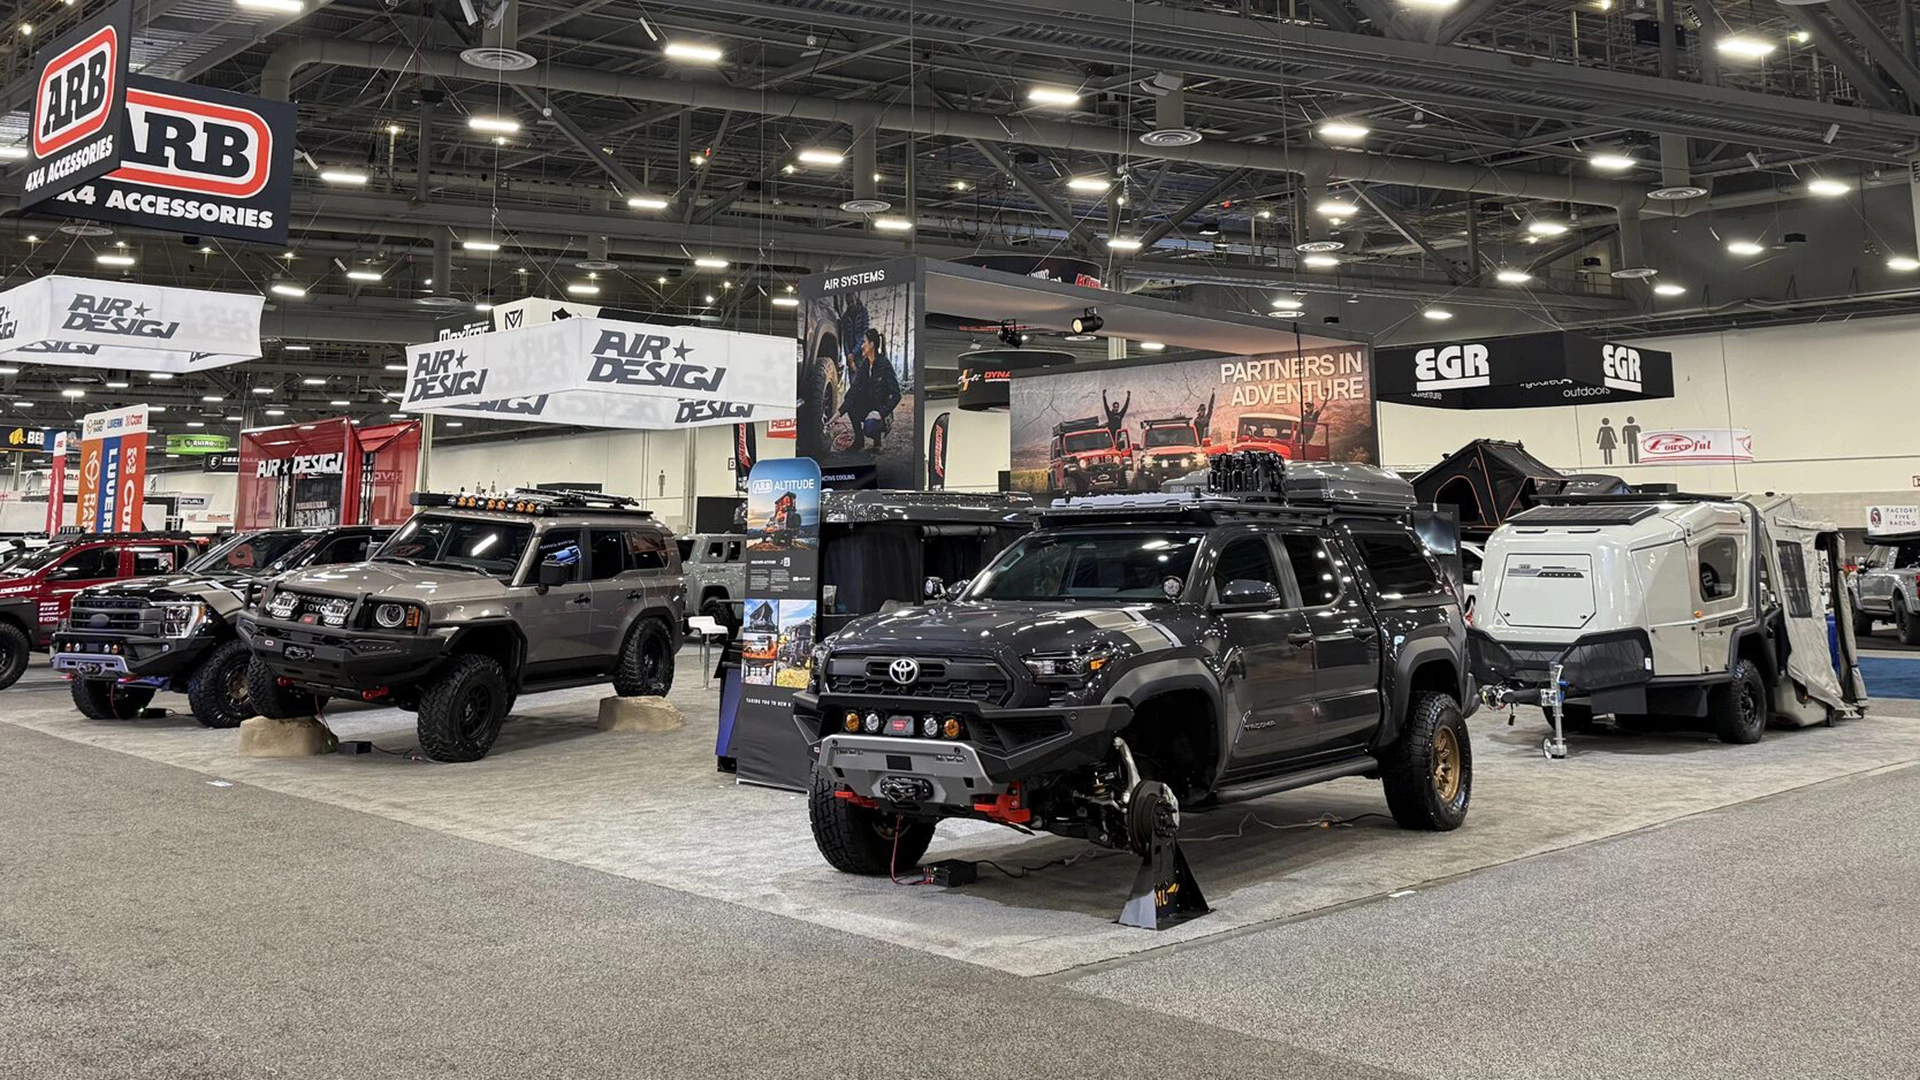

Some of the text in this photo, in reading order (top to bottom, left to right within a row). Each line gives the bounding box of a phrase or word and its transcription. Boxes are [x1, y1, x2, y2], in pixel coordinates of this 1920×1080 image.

[43, 49, 107, 138] ARB
[25, 135, 114, 192] 4X4 ACCESSORIES
[105, 190, 273, 229] ACCESSORIES
[824, 270, 885, 290] AIR SYSTEMS
[68, 293, 133, 317] AIR
[62, 312, 180, 340] DESIGN
[591, 329, 671, 360] AIR
[416, 348, 454, 376] AIR
[587, 356, 727, 392] DESIGN
[1221, 351, 1362, 384] PARTNERS IN
[1415, 344, 1490, 380] EGR
[1603, 344, 1643, 382] EGR
[408, 368, 489, 402] DESIGN
[1231, 377, 1365, 406] ADVENTURE
[1563, 386, 1612, 399] outdoors
[256, 458, 280, 479] AIR
[774, 479, 814, 490] ALTITUDE
